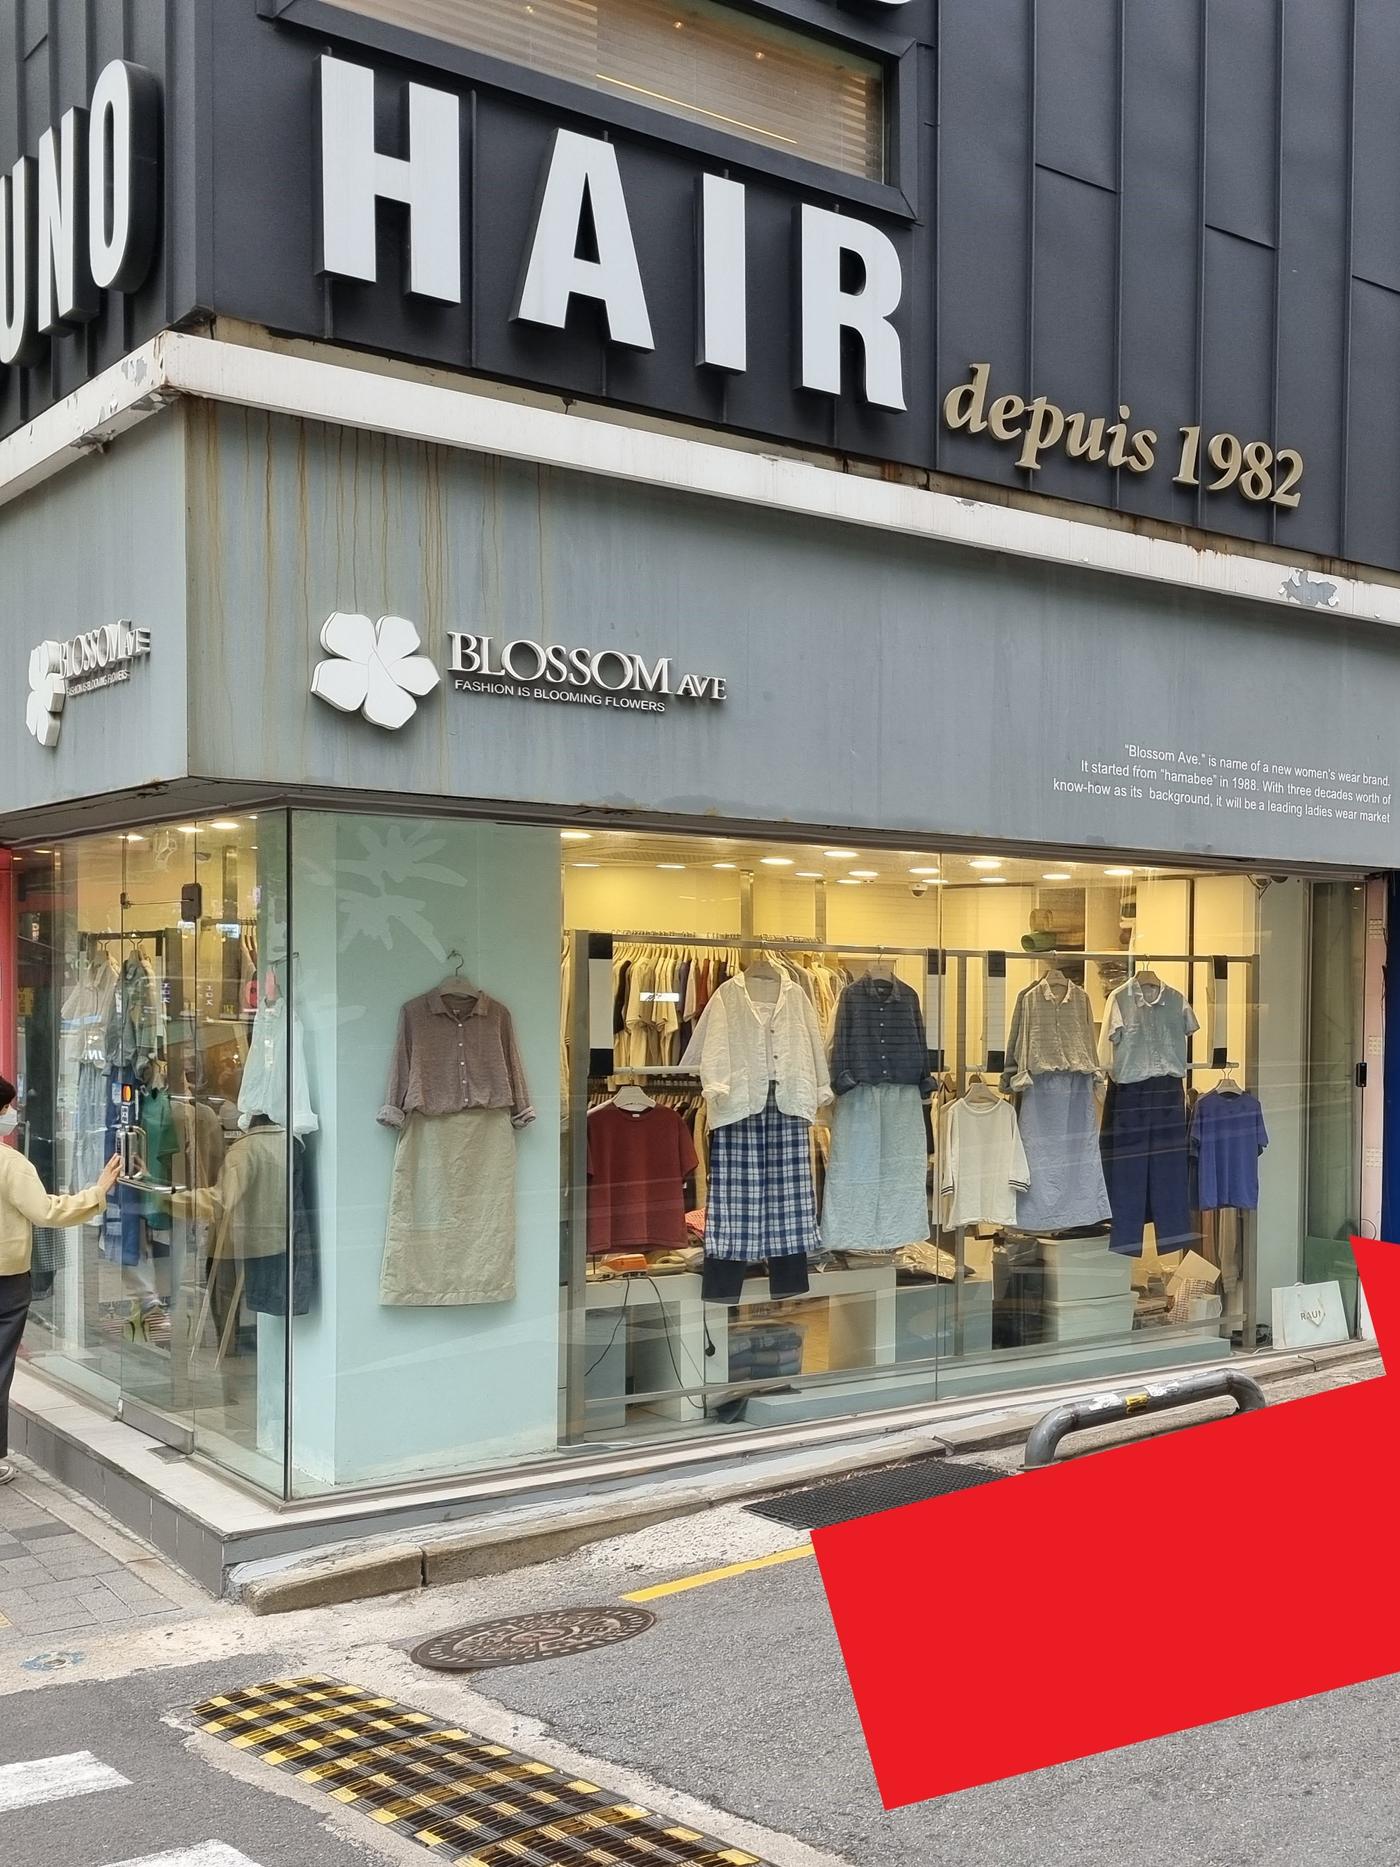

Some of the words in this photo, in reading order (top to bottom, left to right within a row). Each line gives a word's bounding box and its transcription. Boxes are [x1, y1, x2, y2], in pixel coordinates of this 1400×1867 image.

[314, 53, 908, 414] HAIR
[943, 363, 1158, 472] depuis
[1172, 425, 1304, 508] 1982
[447, 631, 673, 694] BLOSSOM
[675, 674, 727, 700] AVE
[455, 679, 514, 696] FASHION
[518, 686, 530, 698] IS
[533, 688, 602, 705] BLOOMING
[605, 696, 665, 712] FLOWERS
[1081, 760, 1089, 772] It
[1091, 762, 1130, 777] started
[1132, 765, 1157, 780] from
[1219, 777, 1229, 788] in
[1232, 777, 1259, 791] 1988.
[1263, 781, 1284, 793] With
[1287, 784, 1312, 796] three
[1314, 787, 1353, 801] decades
[1355, 791, 1380, 804] worth
[1382, 794, 1391, 805] of
[1208, 755, 1217, 767] is
[1219, 758, 1248, 770] name
[1250, 760, 1262, 771] of
[1271, 764, 1292, 775] new
[1338, 771, 1361, 783] wear
[1363, 773, 1391, 786] brand.
[1053, 778, 1111, 795] know-how
[1113, 787, 1127, 797] as
[1130, 785, 1143, 798] its
[1149, 788, 1213, 807] background,
[1216, 795, 1222, 807] it
[1225, 797, 1242, 809] will
[1244, 799, 1257, 810] be
[1267, 800, 1302, 818] leading
[1305, 804, 1333, 818] ladies
[1335, 809, 1357, 820] wear
[1359, 811, 1391, 823] market
